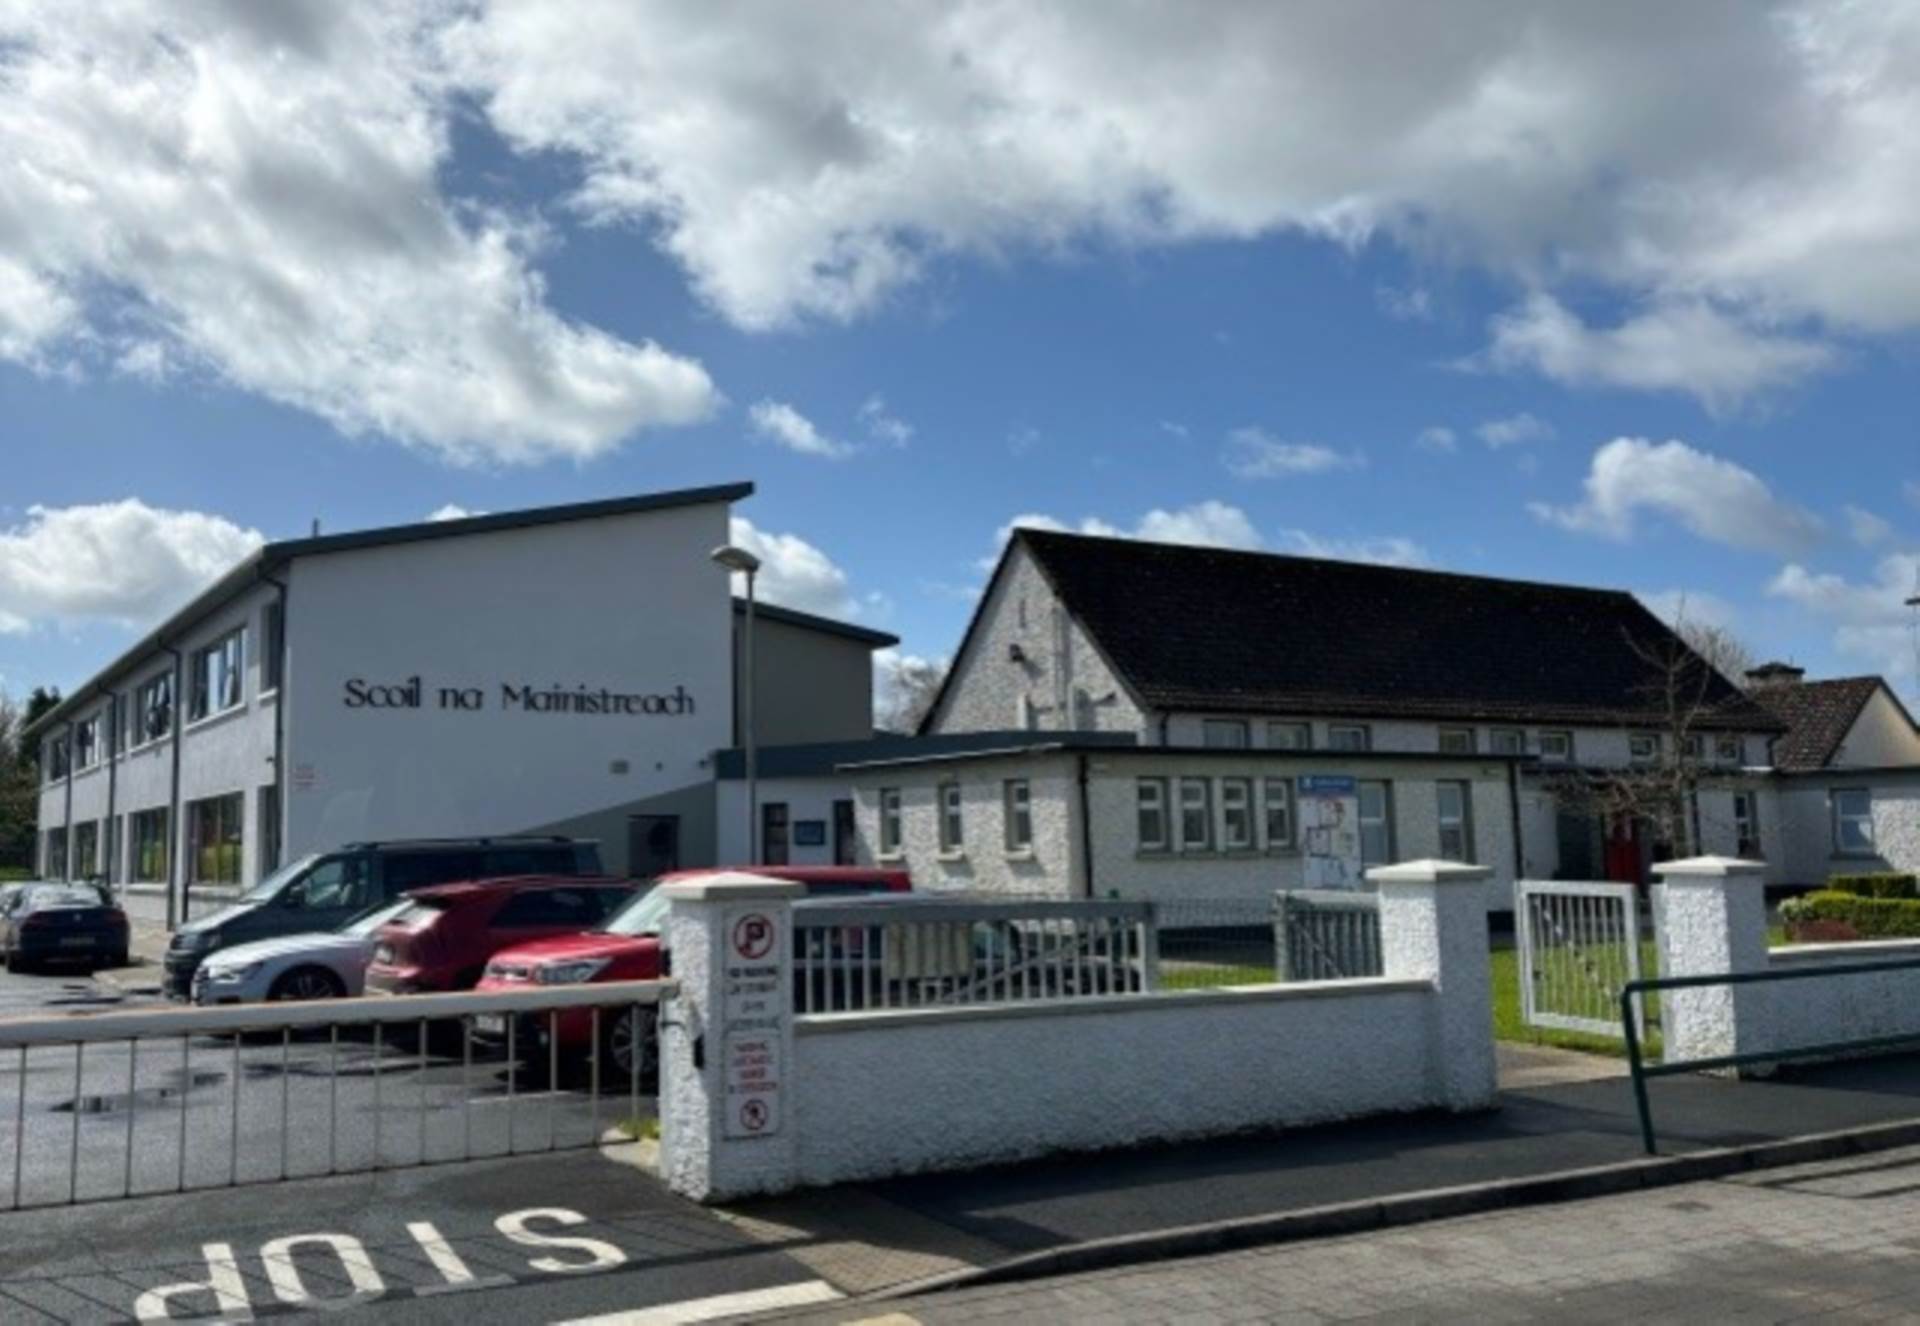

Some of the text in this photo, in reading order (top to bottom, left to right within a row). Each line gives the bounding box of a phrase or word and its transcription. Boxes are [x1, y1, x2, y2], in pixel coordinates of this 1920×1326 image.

[344, 676, 695, 715] Scoil na Mainistreach
[134, 1207, 628, 1326] STOP
